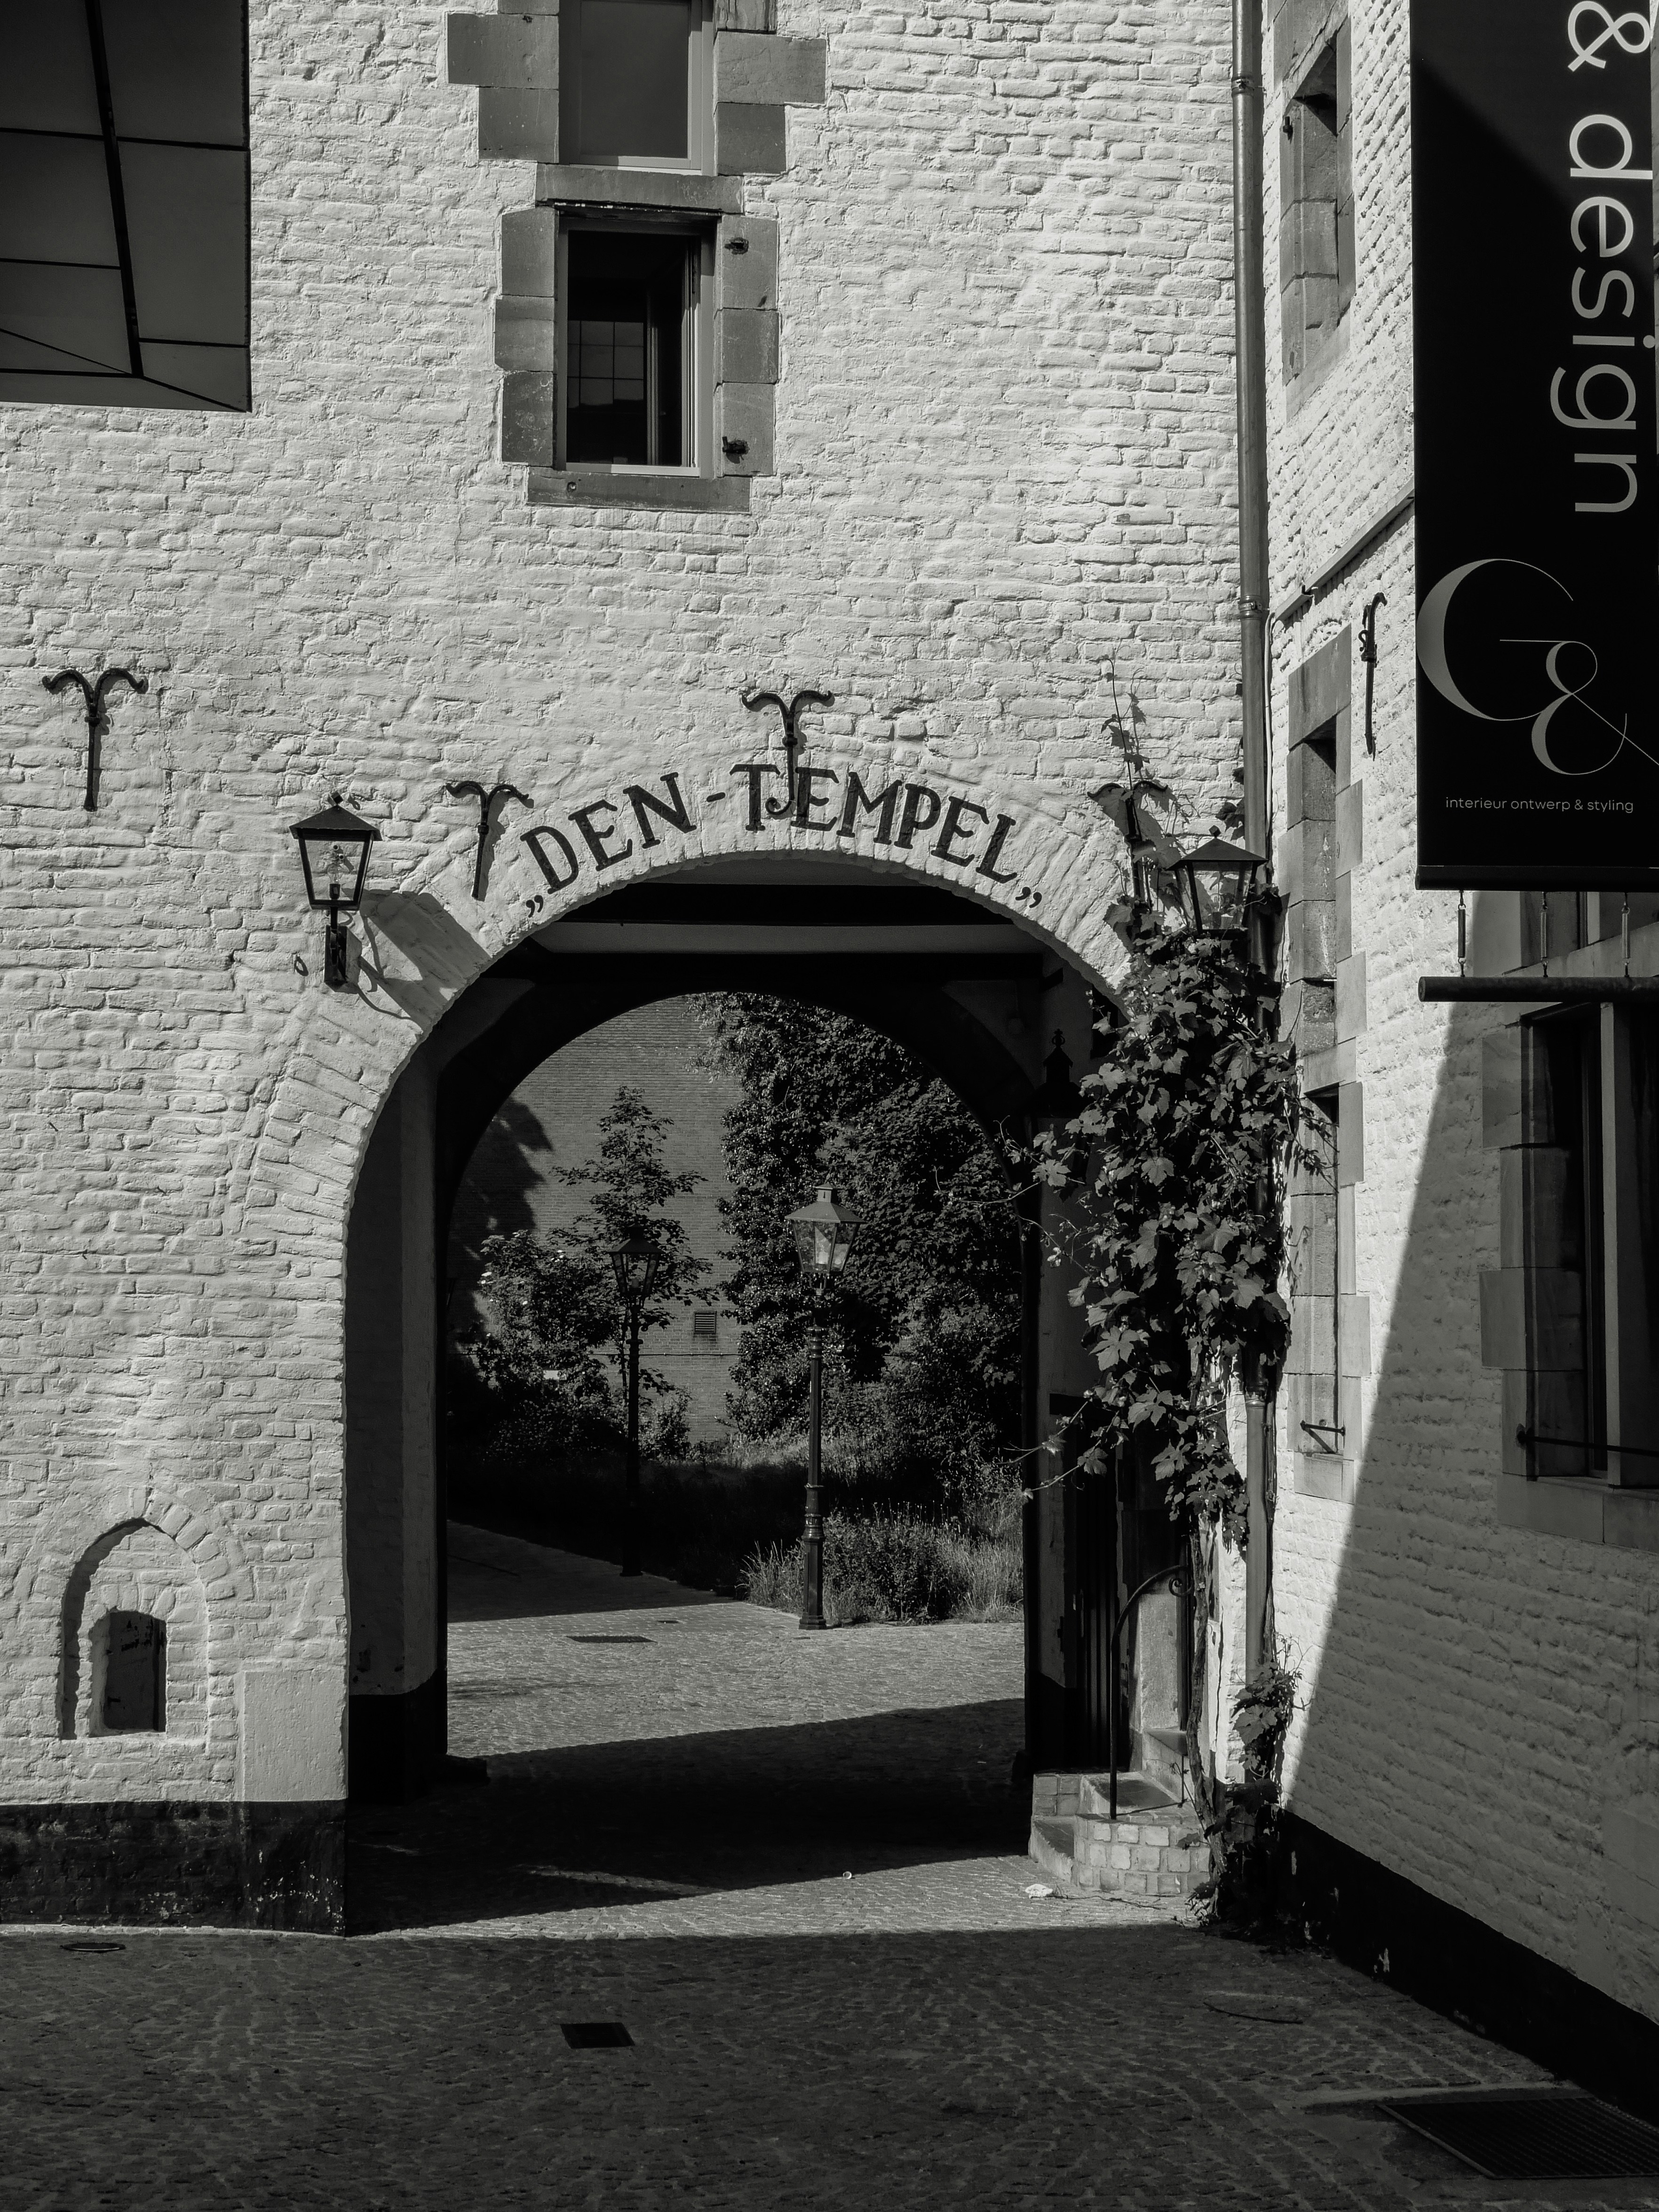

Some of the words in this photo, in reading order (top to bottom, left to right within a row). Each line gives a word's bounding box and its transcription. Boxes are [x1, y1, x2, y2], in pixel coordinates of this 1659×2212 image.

[1568, 0, 1651, 72] &
[1550, 114, 1656, 513] design
[1446, 797, 1507, 809] interieur
[1510, 799, 1570, 812] ontwerp
[1574, 800, 1583, 810] &
[1587, 800, 1633, 813] styling
